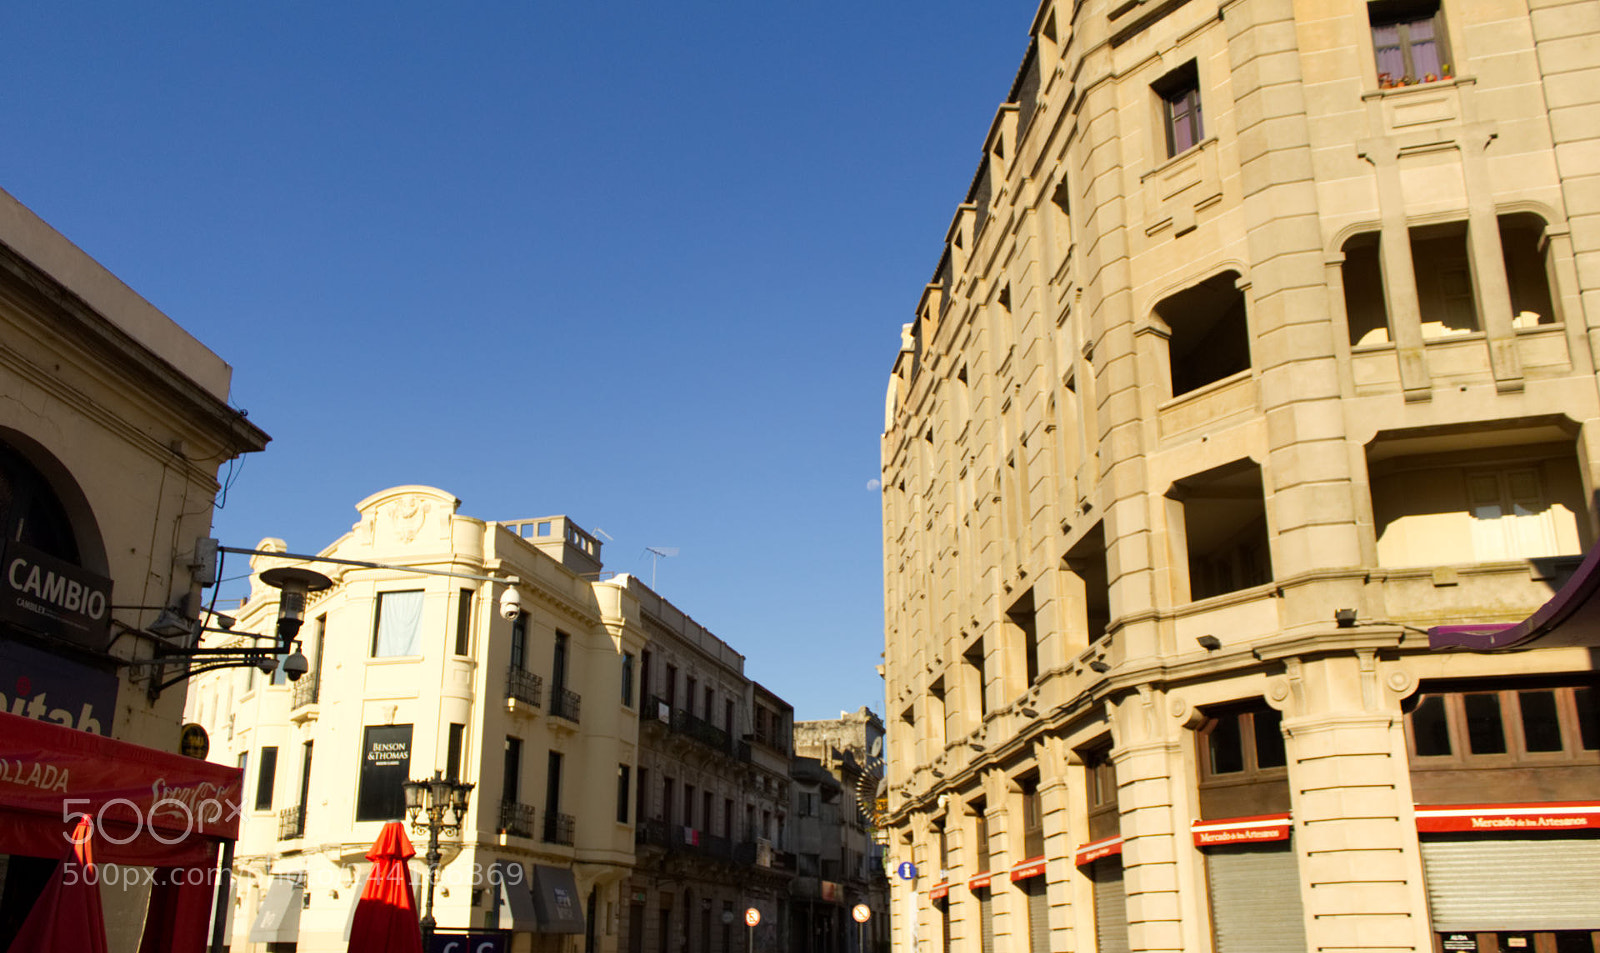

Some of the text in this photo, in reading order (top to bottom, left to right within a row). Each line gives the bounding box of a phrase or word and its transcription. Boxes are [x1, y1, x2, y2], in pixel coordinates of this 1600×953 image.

[8, 558, 106, 620] CAMBIO
[373, 742, 406, 751] BENSON
[367, 751, 409, 760] &THOMAS
[1470, 817, 1516, 827] Mercado
